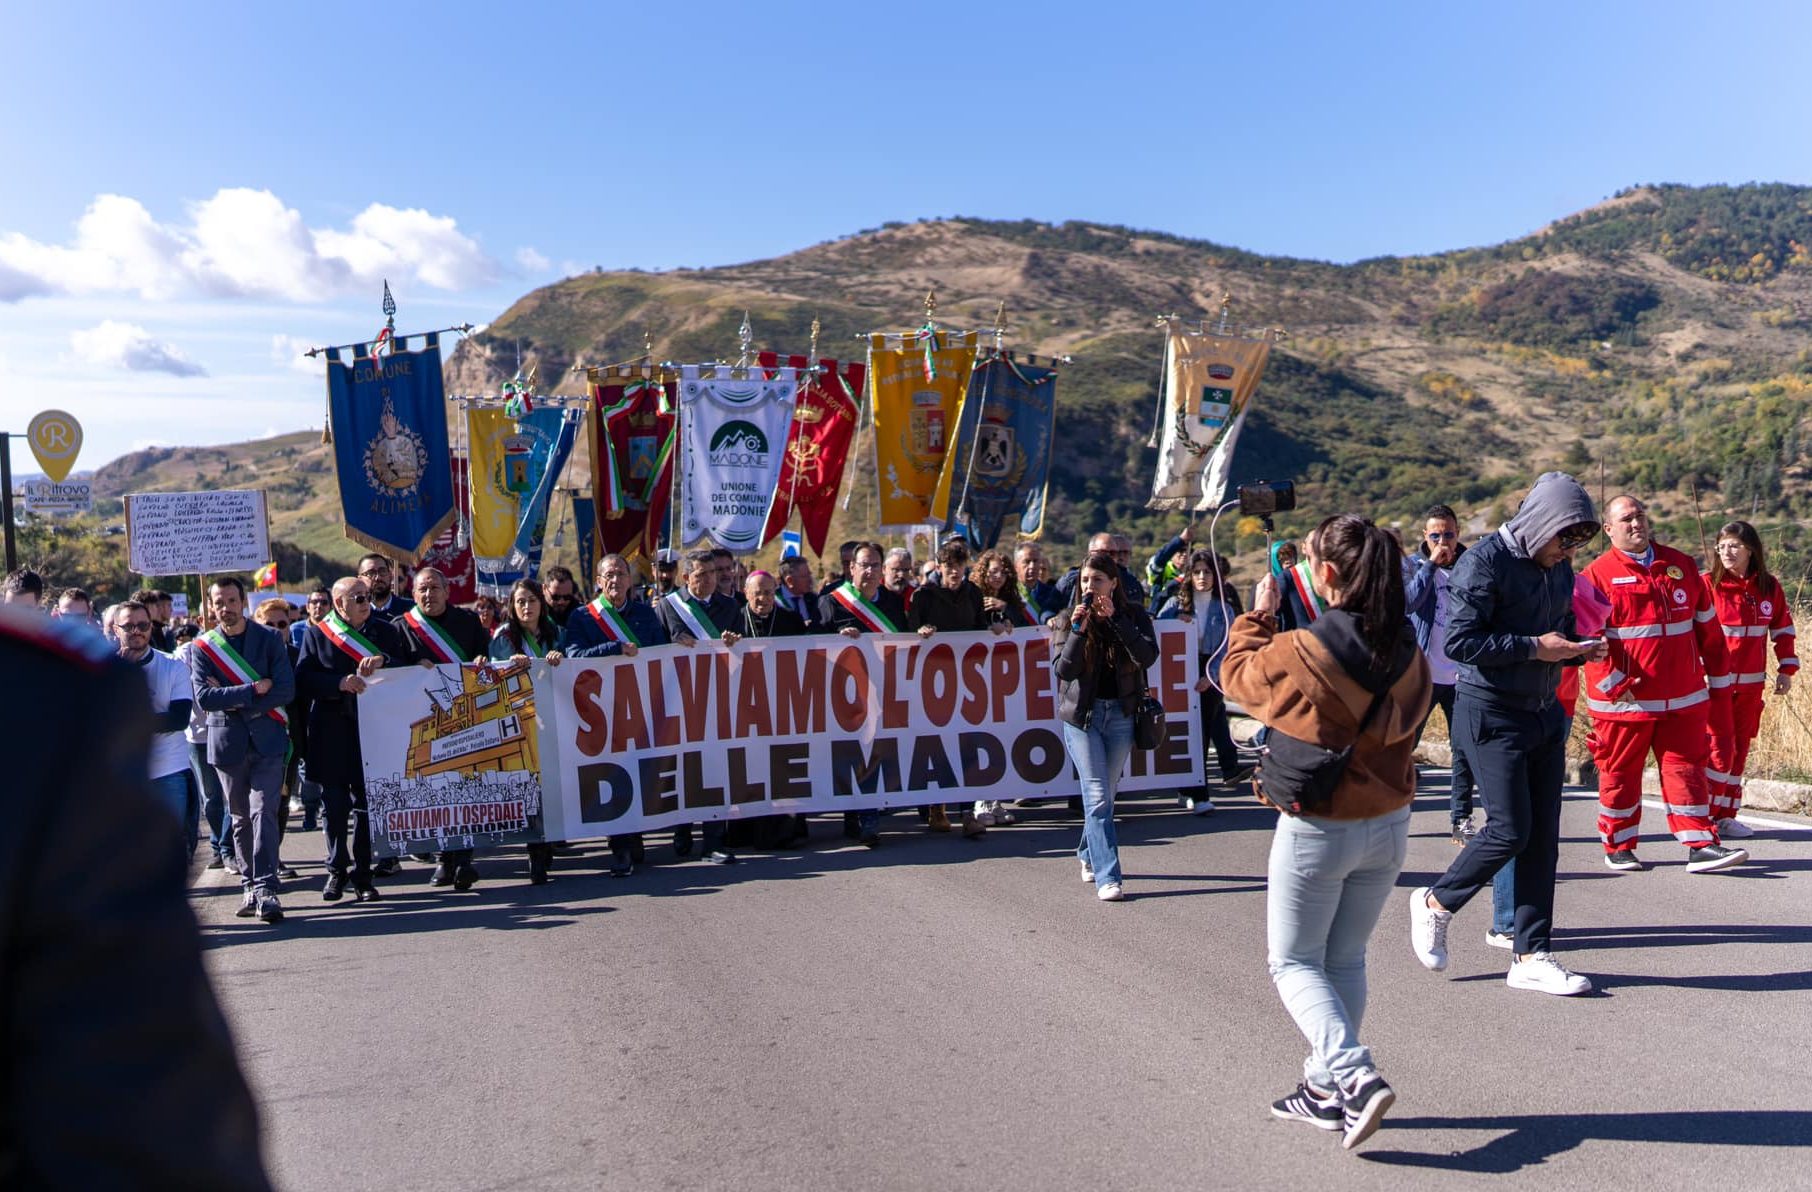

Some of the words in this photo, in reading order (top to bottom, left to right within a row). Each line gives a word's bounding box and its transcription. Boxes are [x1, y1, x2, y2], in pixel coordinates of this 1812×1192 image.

[354, 361, 412, 383] COMUNE
[721, 482, 757, 492] UNIONE
[711, 493, 727, 502] DEI
[729, 493, 767, 504] COMUNI
[712, 504, 766, 517] MADONIE
[573, 646, 869, 756] SALVIAMO
[882, 632, 1189, 728] L'OSPEE
[501, 716, 519, 737] H
[578, 743, 812, 823] DELLE
[831, 721, 1193, 796] MADOIE
[388, 805, 450, 832] SALVIAMO
[453, 802, 524, 826] L'OSPEDALE
[389, 828, 438, 841] DELLE
[443, 820, 527, 837] MADONIE
